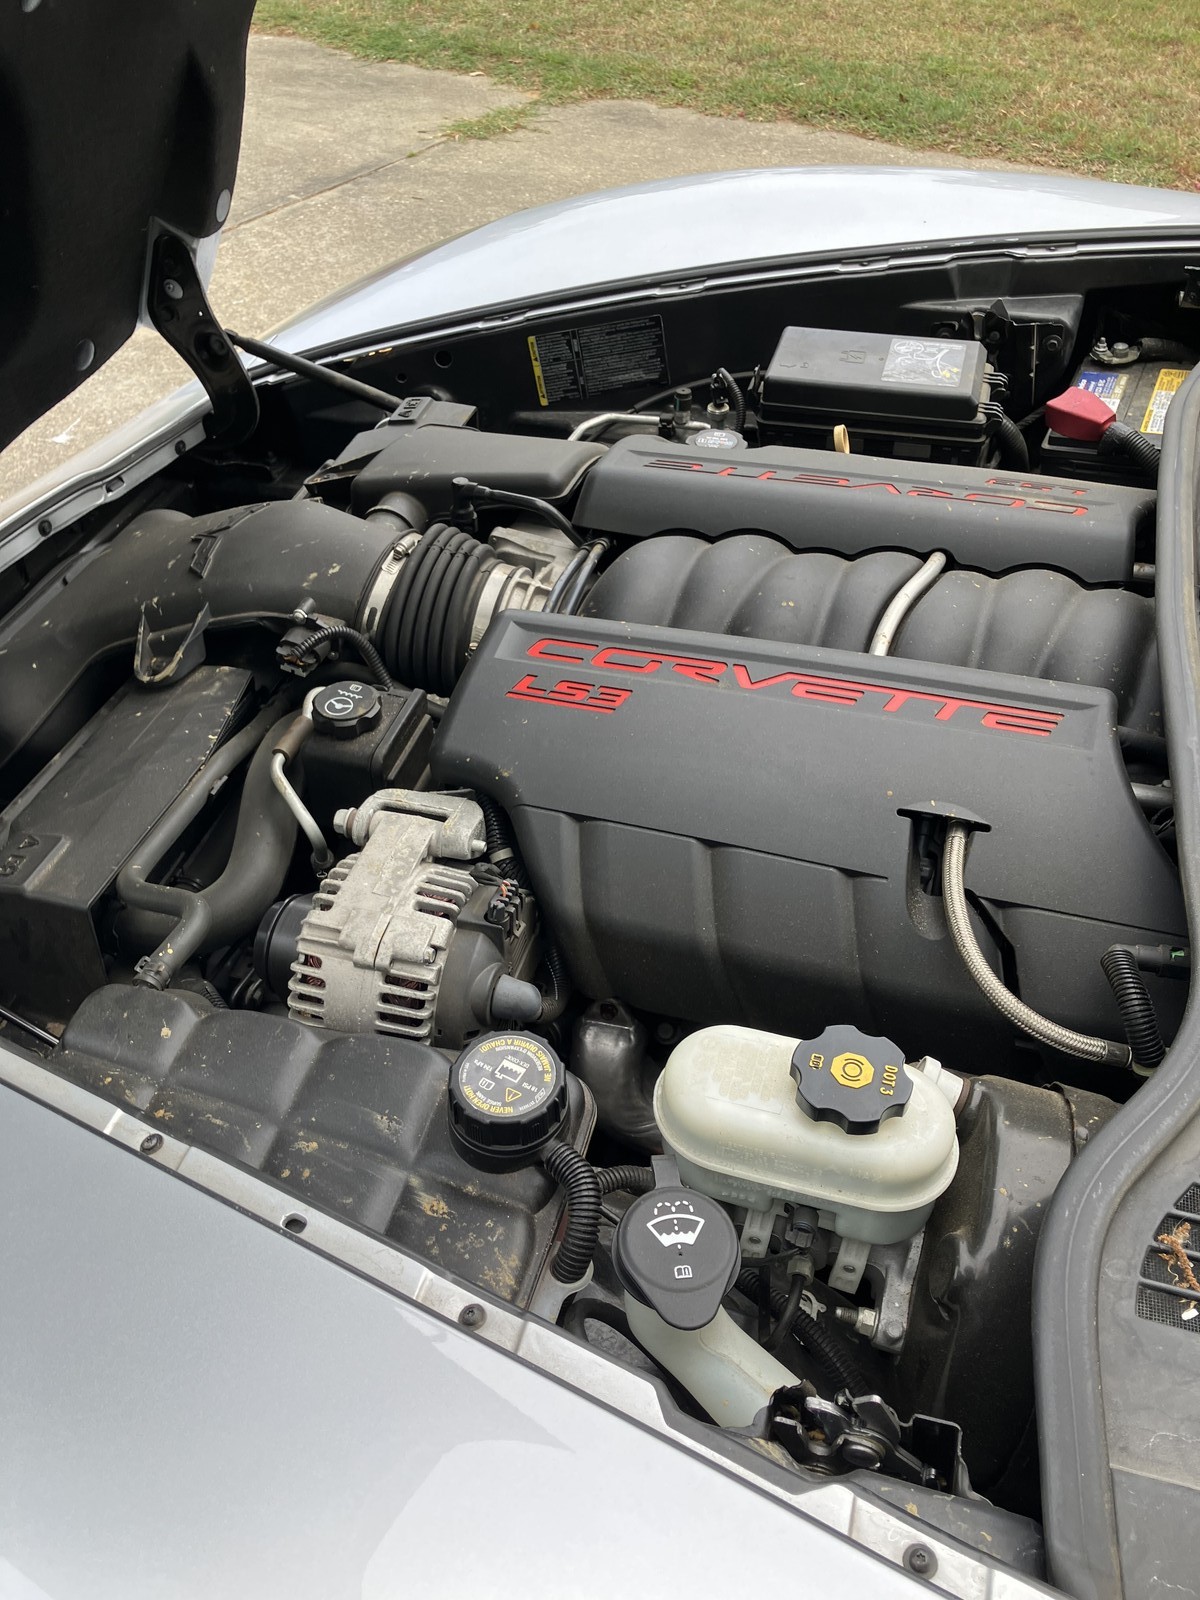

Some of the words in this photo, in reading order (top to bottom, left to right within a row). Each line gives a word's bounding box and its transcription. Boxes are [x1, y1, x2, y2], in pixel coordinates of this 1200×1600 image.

[642, 459, 1089, 516] CORVETTE
[505, 673, 633, 714] LS3
[526, 637, 1065, 737] CORVETTE
[479, 1039, 505, 1053] CHAUD!
[514, 1039, 538, 1053] OUVRIR
[536, 1050, 551, 1073] JAMAIS
[544, 1072, 552, 1082] NE
[882, 1065, 899, 1088] DOT
[463, 1084, 476, 1100] HOT!
[880, 1087, 894, 1096] 3
[472, 1097, 490, 1110] OPEN
[490, 1105, 514, 1114] NEVER
